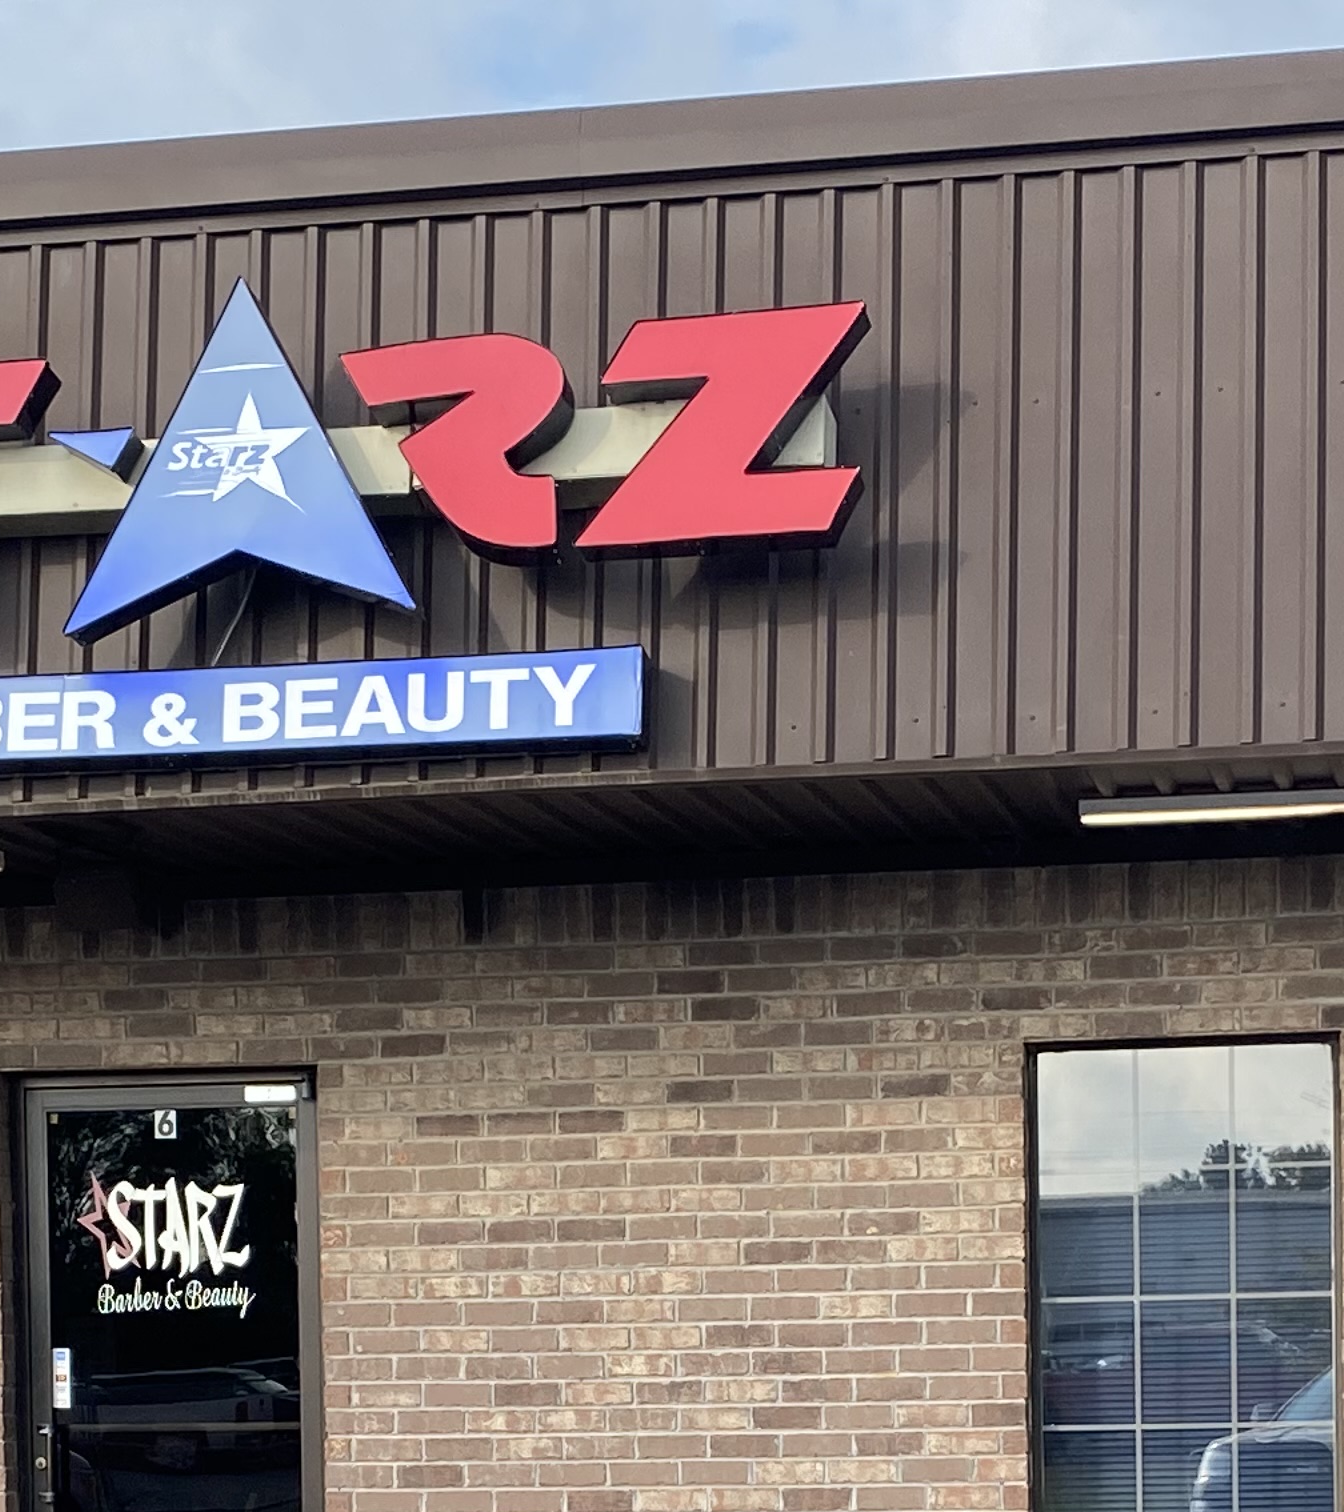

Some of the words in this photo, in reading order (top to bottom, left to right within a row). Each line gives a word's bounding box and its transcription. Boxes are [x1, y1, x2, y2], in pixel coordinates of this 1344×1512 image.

[167, 441, 270, 471] Starz
[149, 699, 199, 747] &
[222, 663, 596, 743] BEAUTY
[158, 1110, 174, 1136] 6
[106, 1177, 250, 1277] STARZ
[97, 1276, 163, 1314] Barber
[164, 1278, 183, 1311] &
[185, 1279, 256, 1319] Beauty
